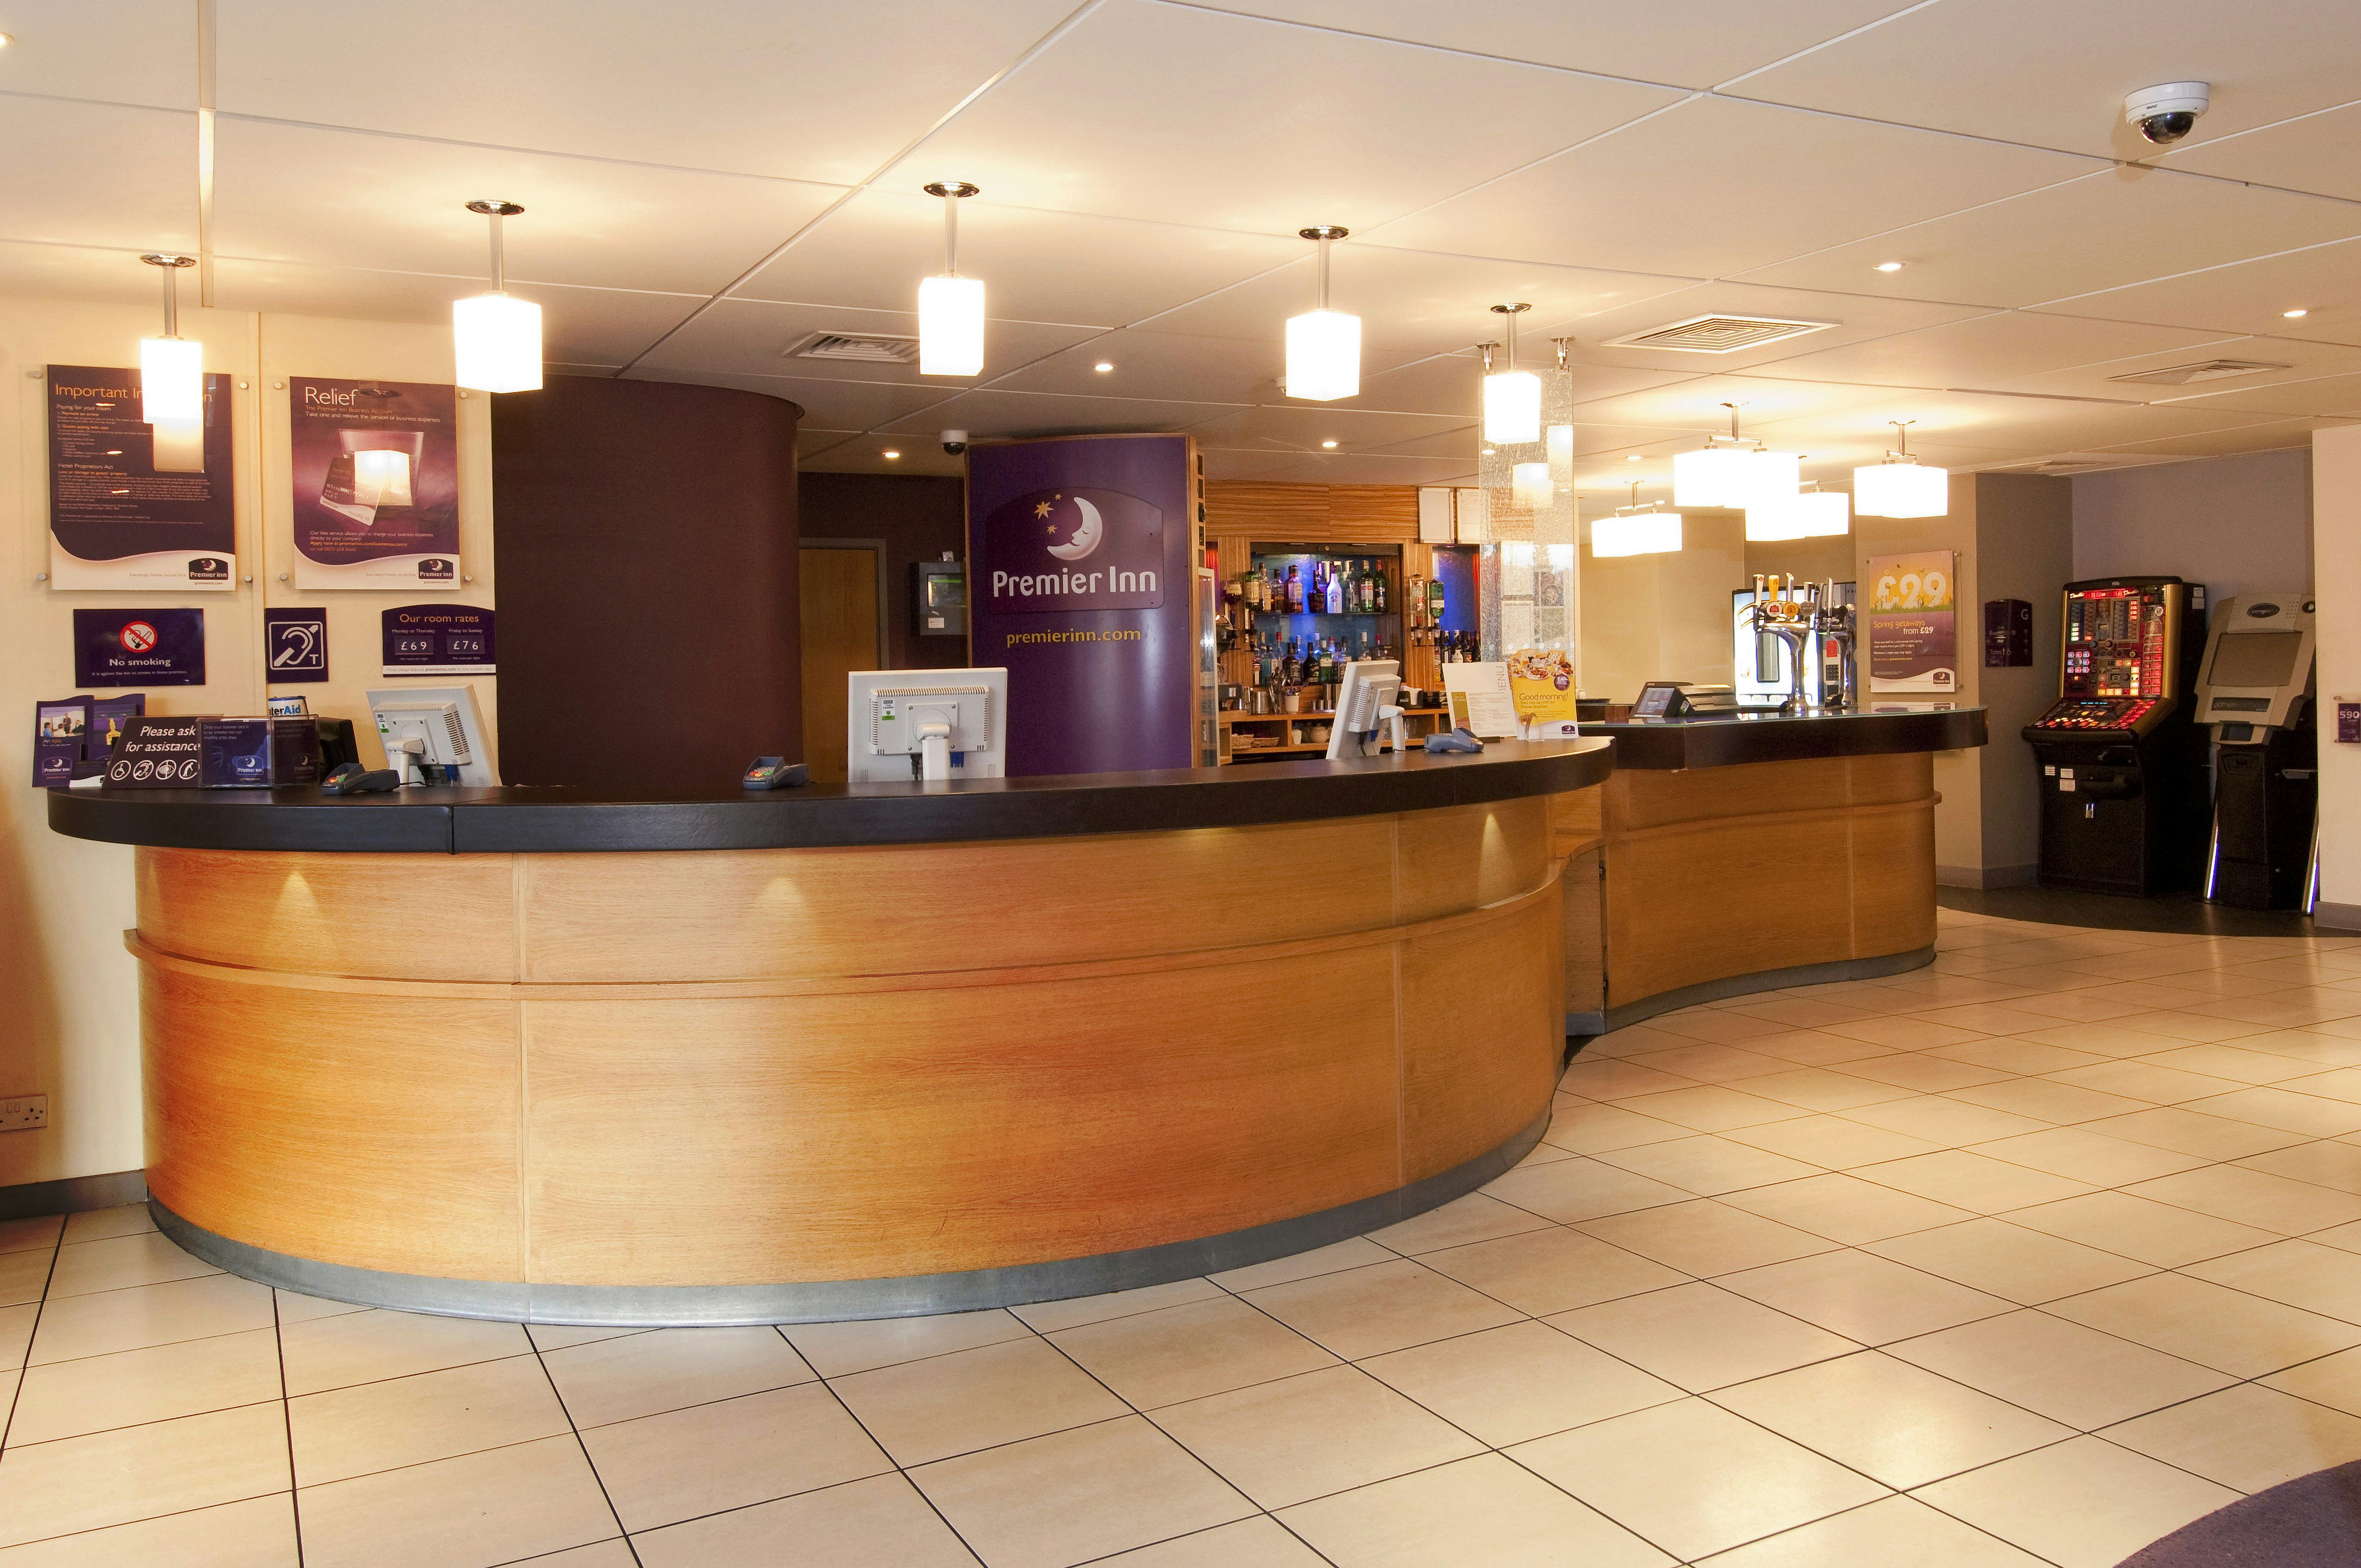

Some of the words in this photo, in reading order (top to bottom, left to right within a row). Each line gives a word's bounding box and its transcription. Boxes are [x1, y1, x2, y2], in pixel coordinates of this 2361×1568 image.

[56, 383, 128, 399] Important
[306, 386, 358, 405] Relief
[993, 568, 1102, 597] Premier
[1109, 566, 1156, 592] Inn
[1876, 572, 1946, 610] £29
[400, 614, 421, 623] Our
[2021, 609, 2028, 620] G
[1007, 628, 1141, 648] premierinn.com
[128, 658, 171, 667] smoking
[1540, 693, 1568, 701] morning!
[269, 704, 301, 715] aterAid
[2340, 711, 2360, 719] 590
[140, 726, 175, 736] Please
[177, 725, 196, 736] ask
[125, 742, 143, 752] for
[145, 741, 200, 752] assistance
